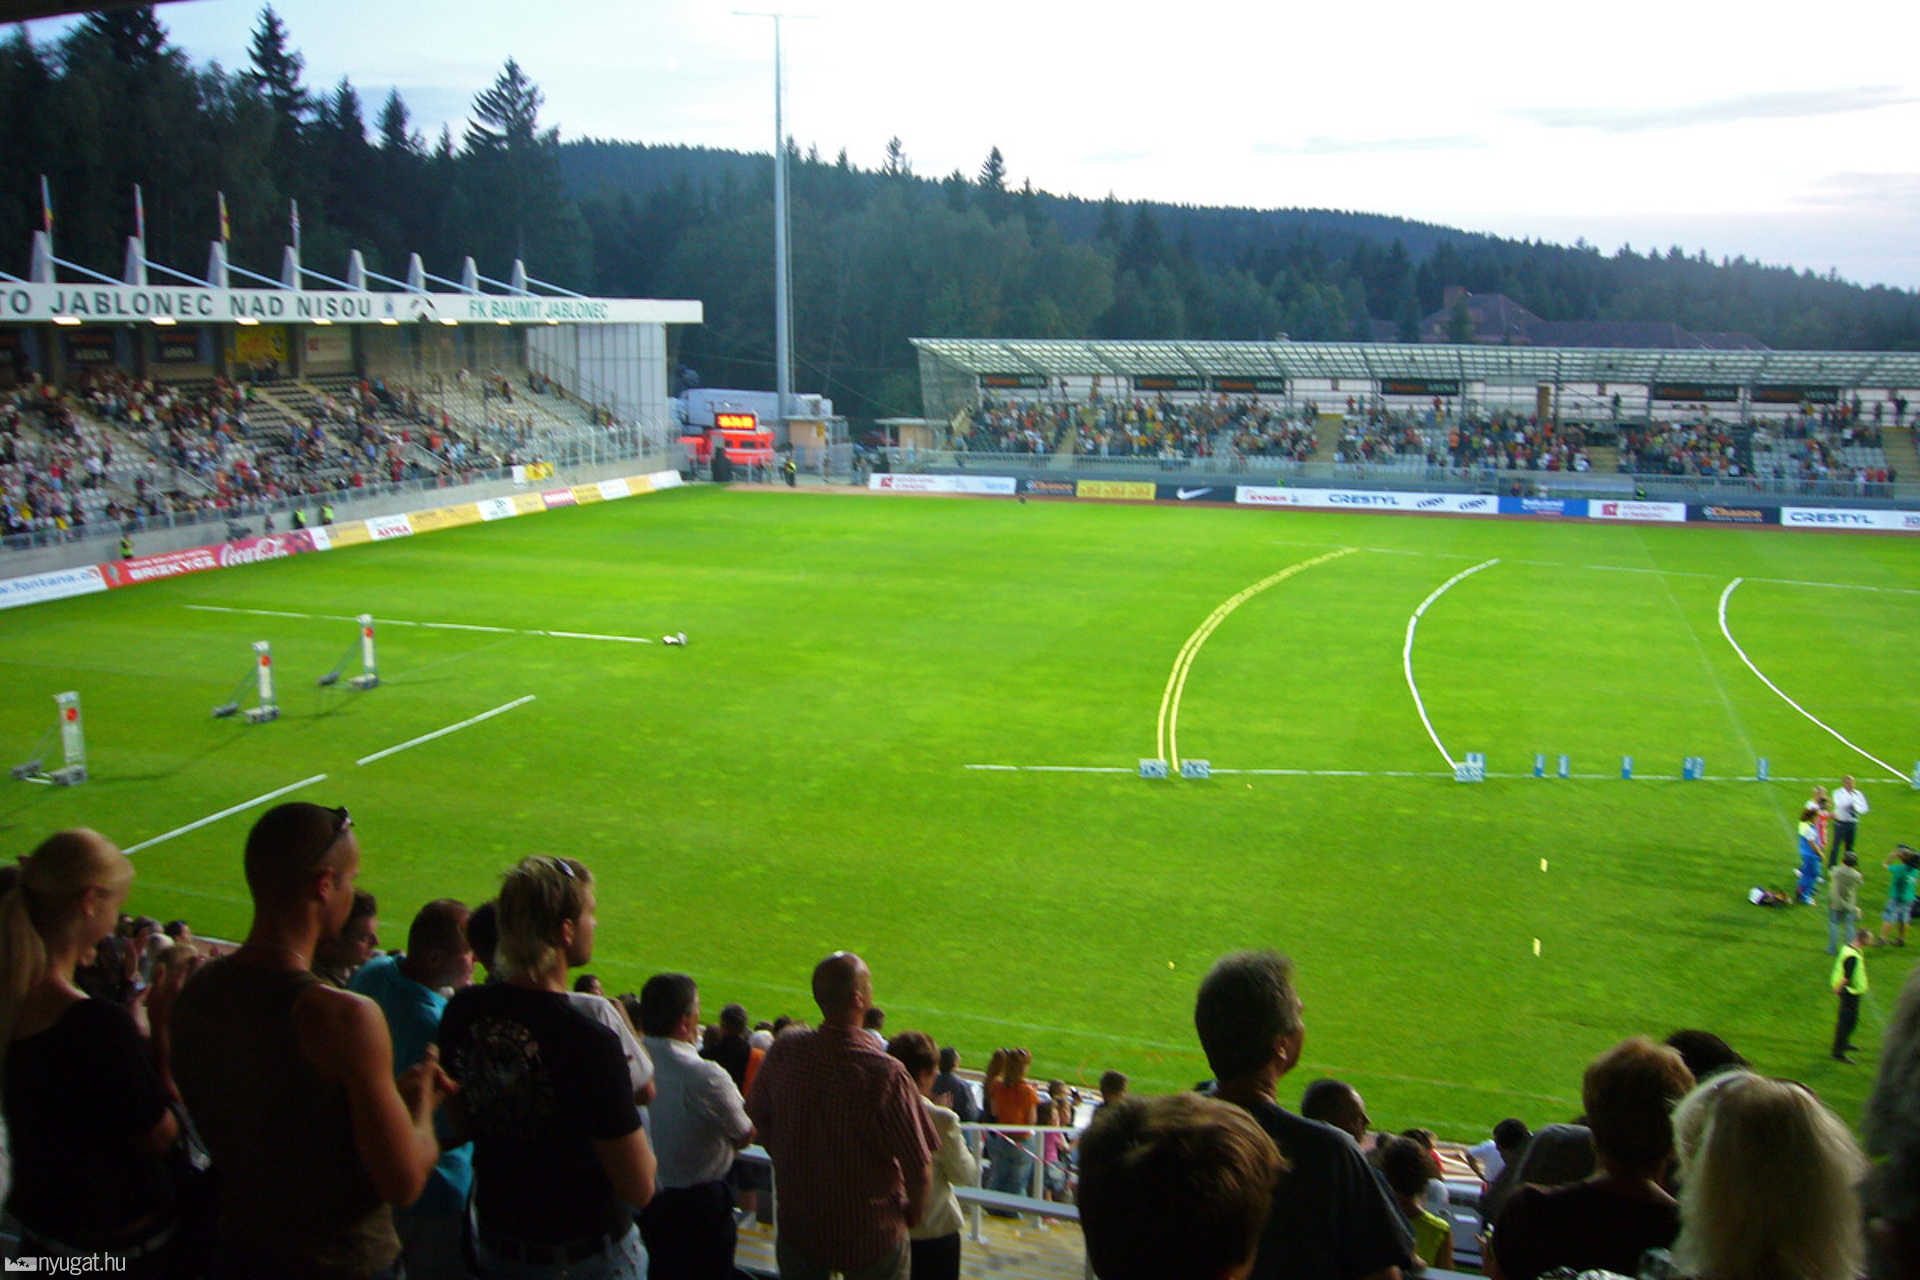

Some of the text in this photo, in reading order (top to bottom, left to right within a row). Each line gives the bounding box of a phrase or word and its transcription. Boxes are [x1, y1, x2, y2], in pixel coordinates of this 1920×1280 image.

[50, 291, 213, 316] JABLONEC
[229, 295, 284, 317] NAD
[297, 297, 371, 318] NISOU
[470, 301, 608, 320] FK BAUMIT JABLONEC
[1328, 493, 1400, 506] CRESTYL
[1790, 511, 1875, 525] CRESTYL
